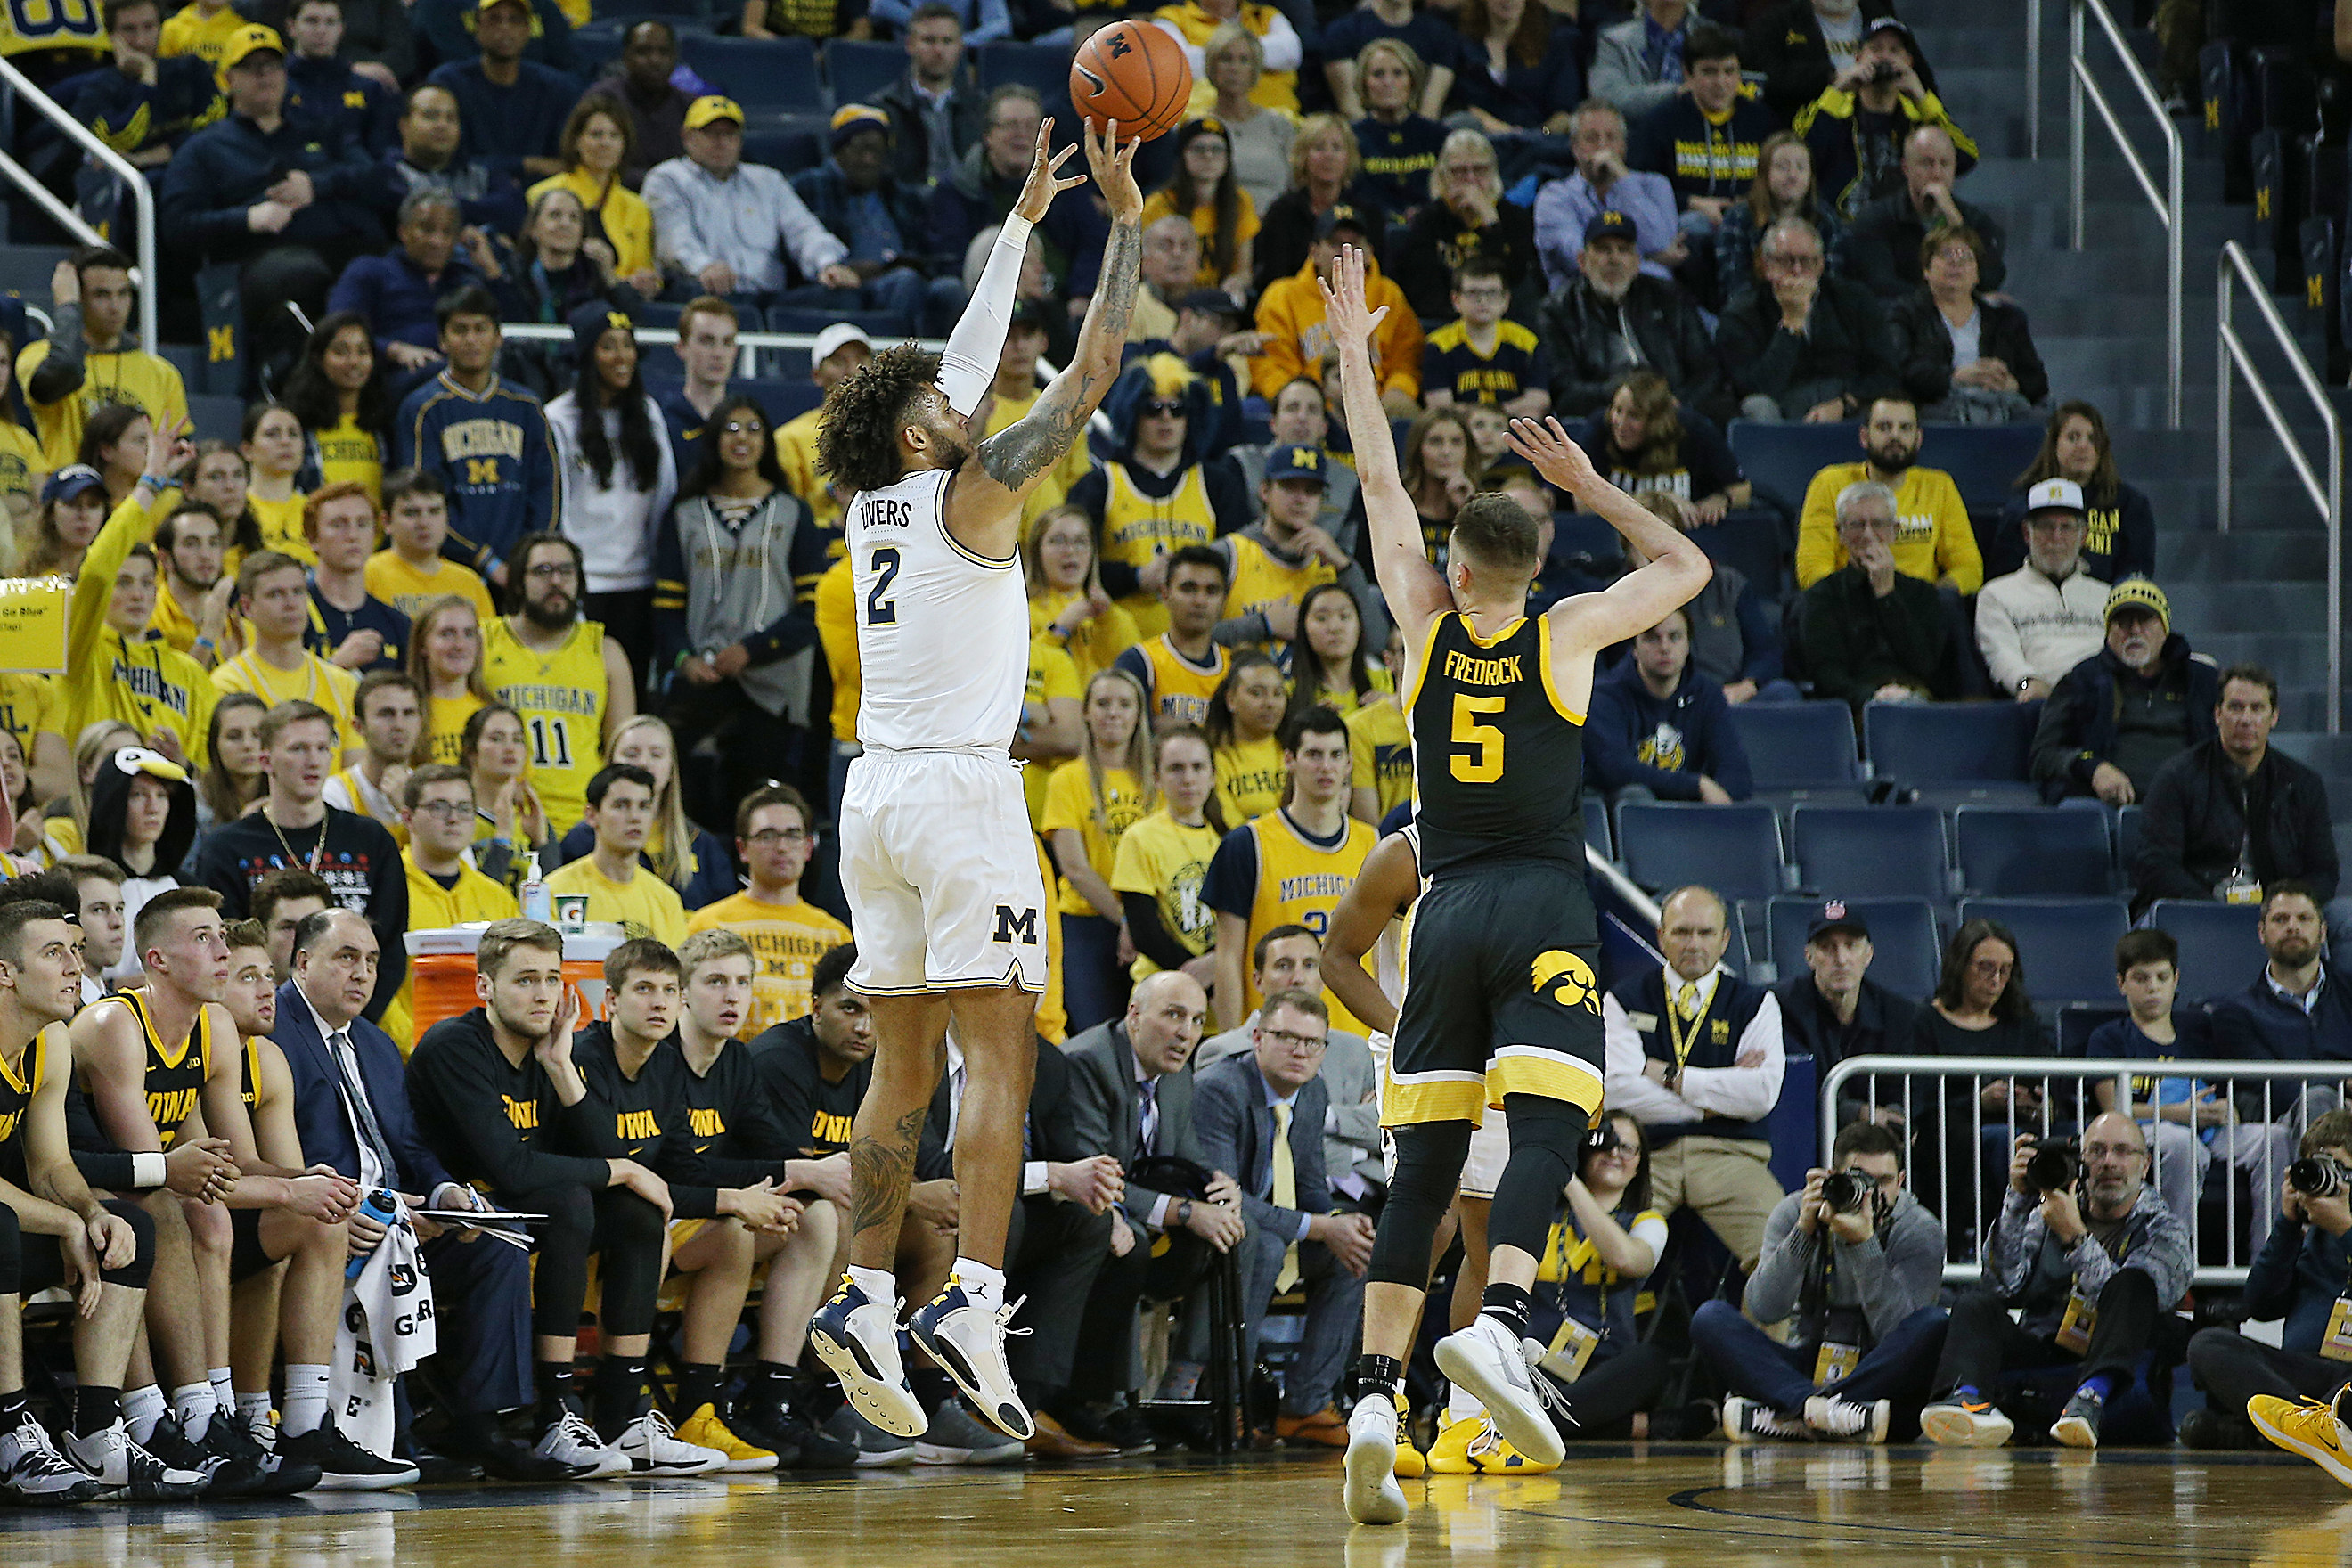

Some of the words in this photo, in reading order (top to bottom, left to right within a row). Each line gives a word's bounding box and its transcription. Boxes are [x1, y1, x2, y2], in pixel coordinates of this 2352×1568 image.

[1106, 33, 1131, 60] M
[466, 459, 501, 485] M
[1293, 447, 1318, 470] M
[867, 546, 901, 626] 2
[496, 684, 597, 716] MICHIGAN
[529, 715, 573, 768] 11
[1450, 693, 1506, 784] 5
[1280, 874, 1354, 902] MICHIG
[561, 901, 584, 927] G
[992, 903, 1038, 945] M
[144, 1087, 197, 1124] OWA
